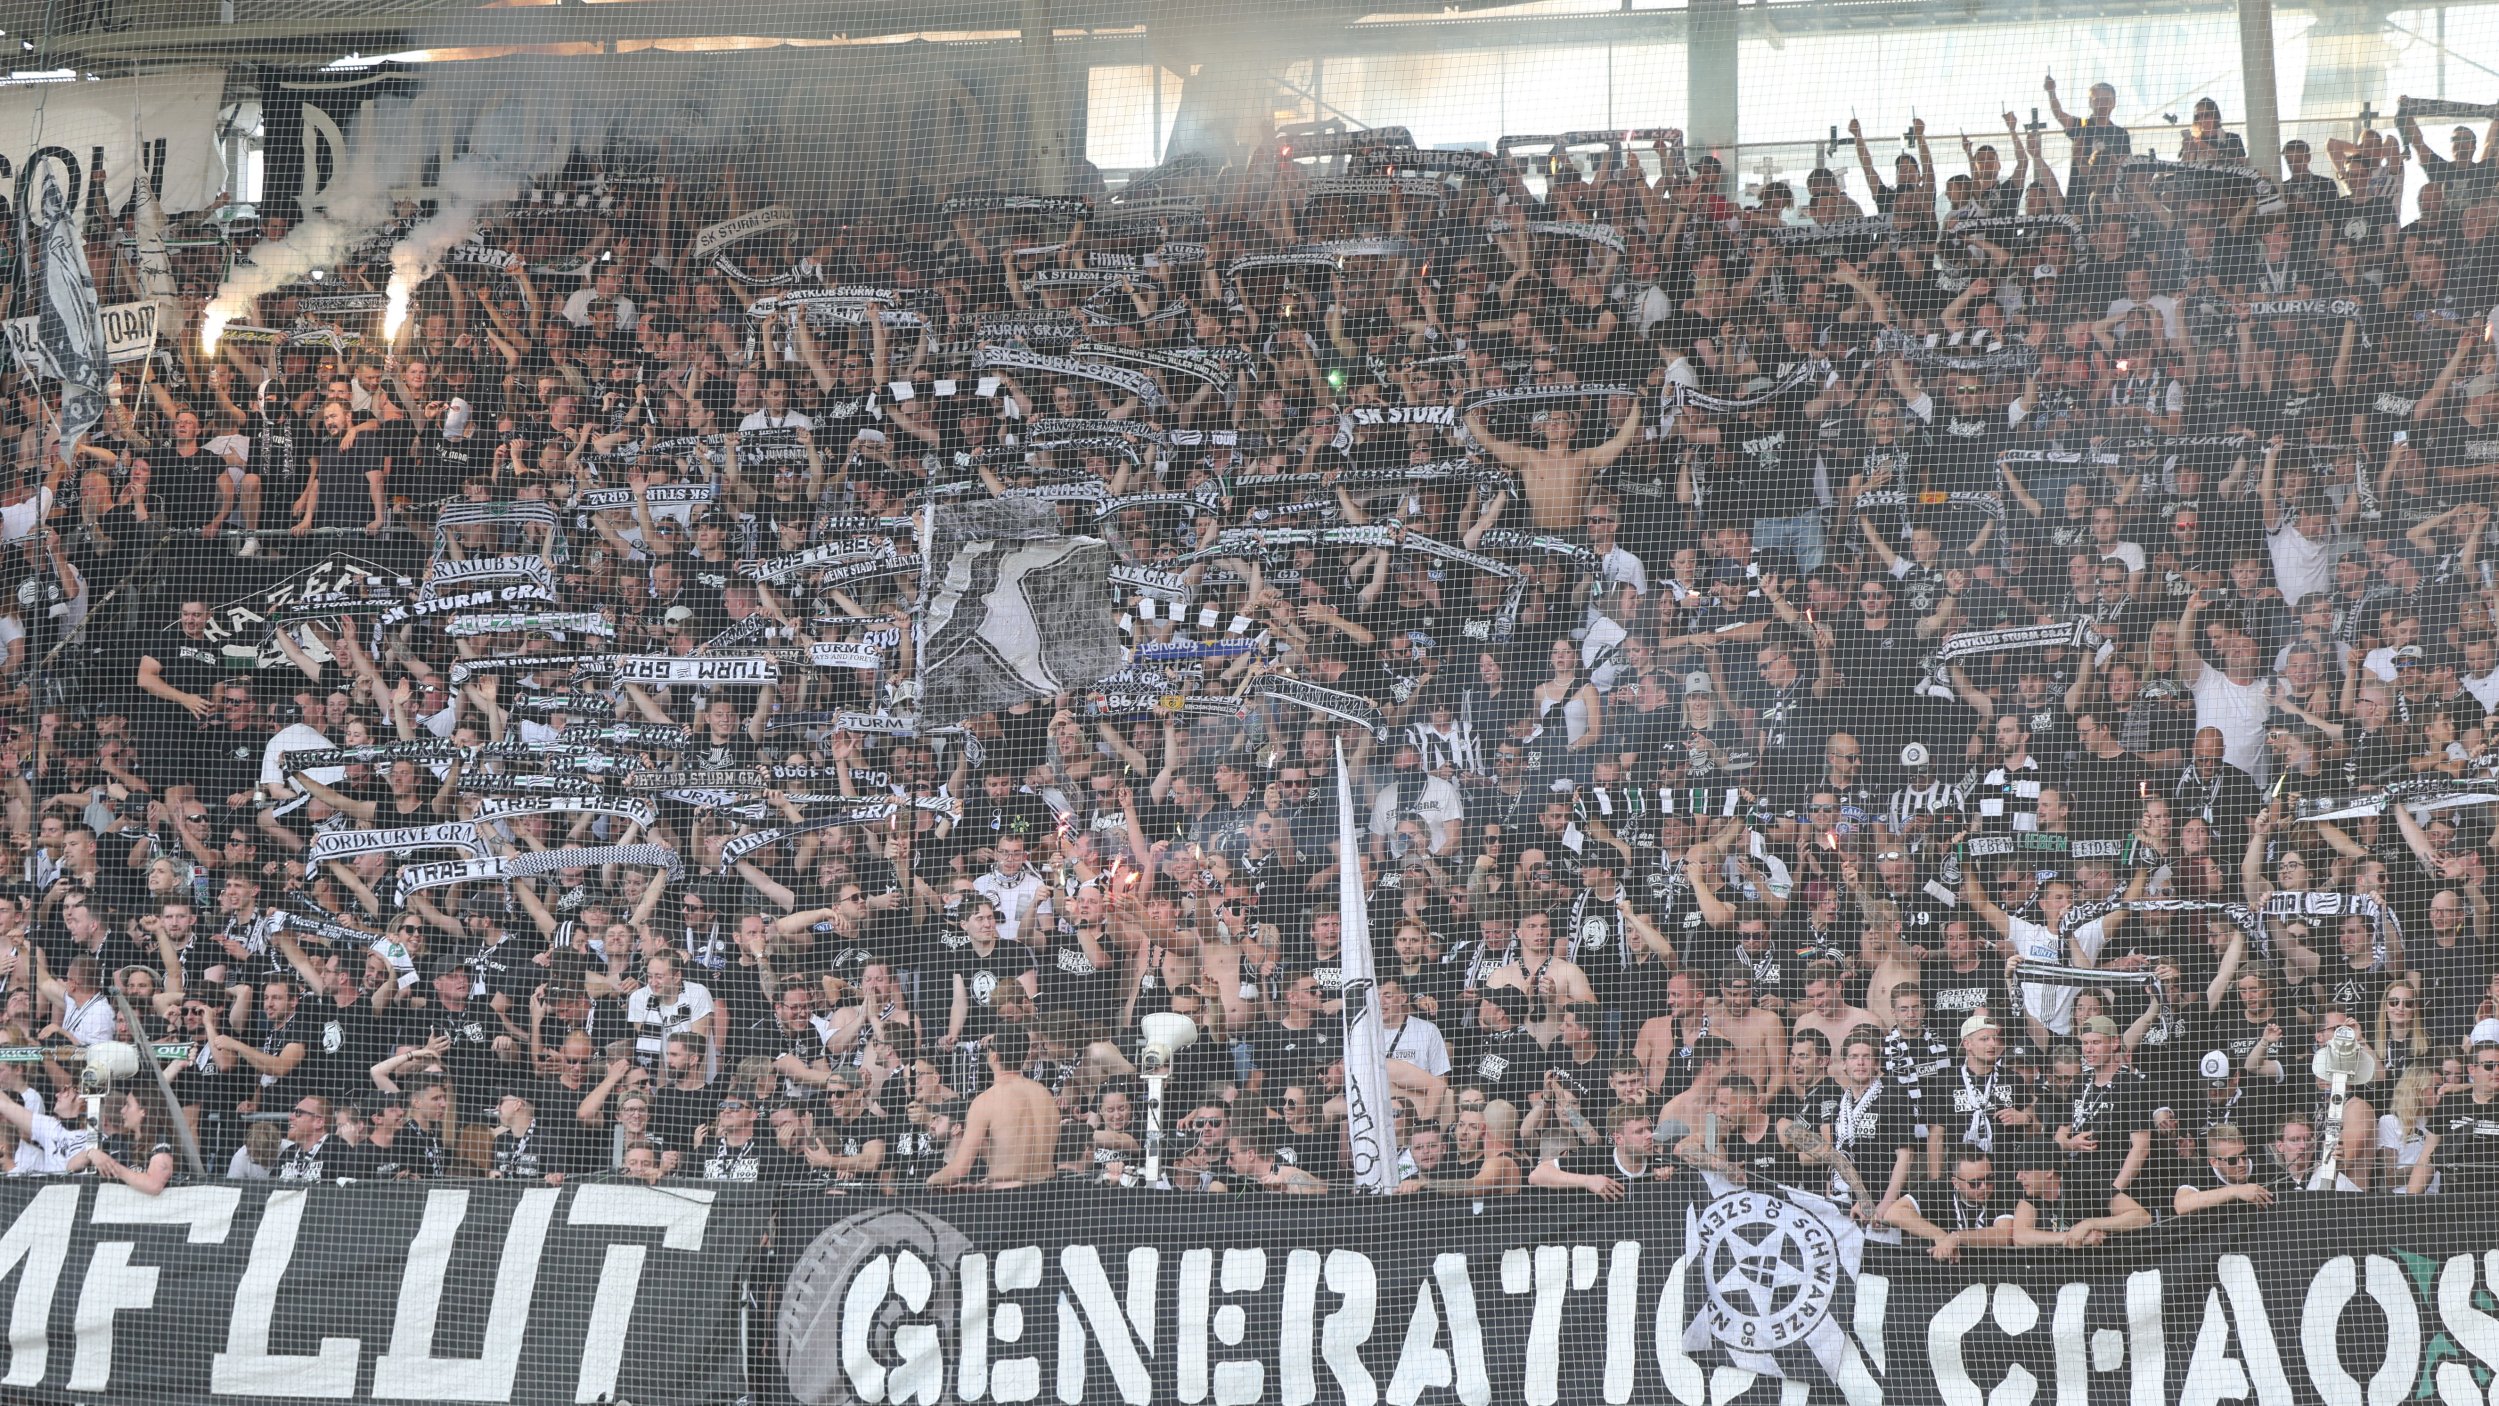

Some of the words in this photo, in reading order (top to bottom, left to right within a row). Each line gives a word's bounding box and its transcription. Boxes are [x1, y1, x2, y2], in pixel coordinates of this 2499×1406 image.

[700, 230, 717, 248] SK
[718, 216, 761, 240] STURM
[1051, 271, 1100, 282] STURM
[786, 288, 836, 301] ORTKLUB
[837, 287, 873, 299] STURM
[1033, 324, 1075, 339] GRAZ
[991, 351, 1019, 364] SK
[1020, 353, 1080, 376] STURM
[1086, 364, 1138, 388] GRAZ
[1485, 386, 1508, 398] SK
[1513, 383, 1576, 397] STURM
[1354, 407, 1385, 425] SK
[1211, 433, 1238, 446] TOUR
[765, 447, 809, 462] JUVENTU
[647, 478, 687, 500] STUR
[690, 477, 710, 492] SK
[590, 490, 630, 506] GRAZ
[823, 568, 850, 586] MEINE
[851, 561, 878, 578] STADT
[885, 557, 910, 571] MEIN
[910, 554, 925, 567] TE
[292, 602, 311, 613] SK
[312, 600, 361, 612] STURM
[381, 605, 412, 625] SK
[413, 590, 493, 616] STURM
[1942, 636, 2000, 655] SPORTKLUB
[2001, 630, 2040, 645] STURM
[2039, 627, 2073, 642] GRAZ
[699, 660, 778, 681] STURM
[838, 716, 905, 730] STURM
[690, 770, 734, 787] STURM
[738, 770, 767, 788] GRA
[773, 764, 819, 780] 1998
[1841, 806, 1868, 823] GAMER
[315, 826, 432, 855] NORDKURVE
[436, 824, 476, 845] GRA
[722, 828, 781, 864] TURM
[1968, 837, 2014, 856] LEBEN
[2016, 832, 2067, 852] LIEBEN
[404, 860, 468, 887] TRAS
[157, 1045, 191, 1057] OUT
[2230, 1040, 2247, 1049] LOVE
[1770, 1217, 1832, 1342] SCHWARZE
[1928, 1248, 2499, 1406] CHAOS
